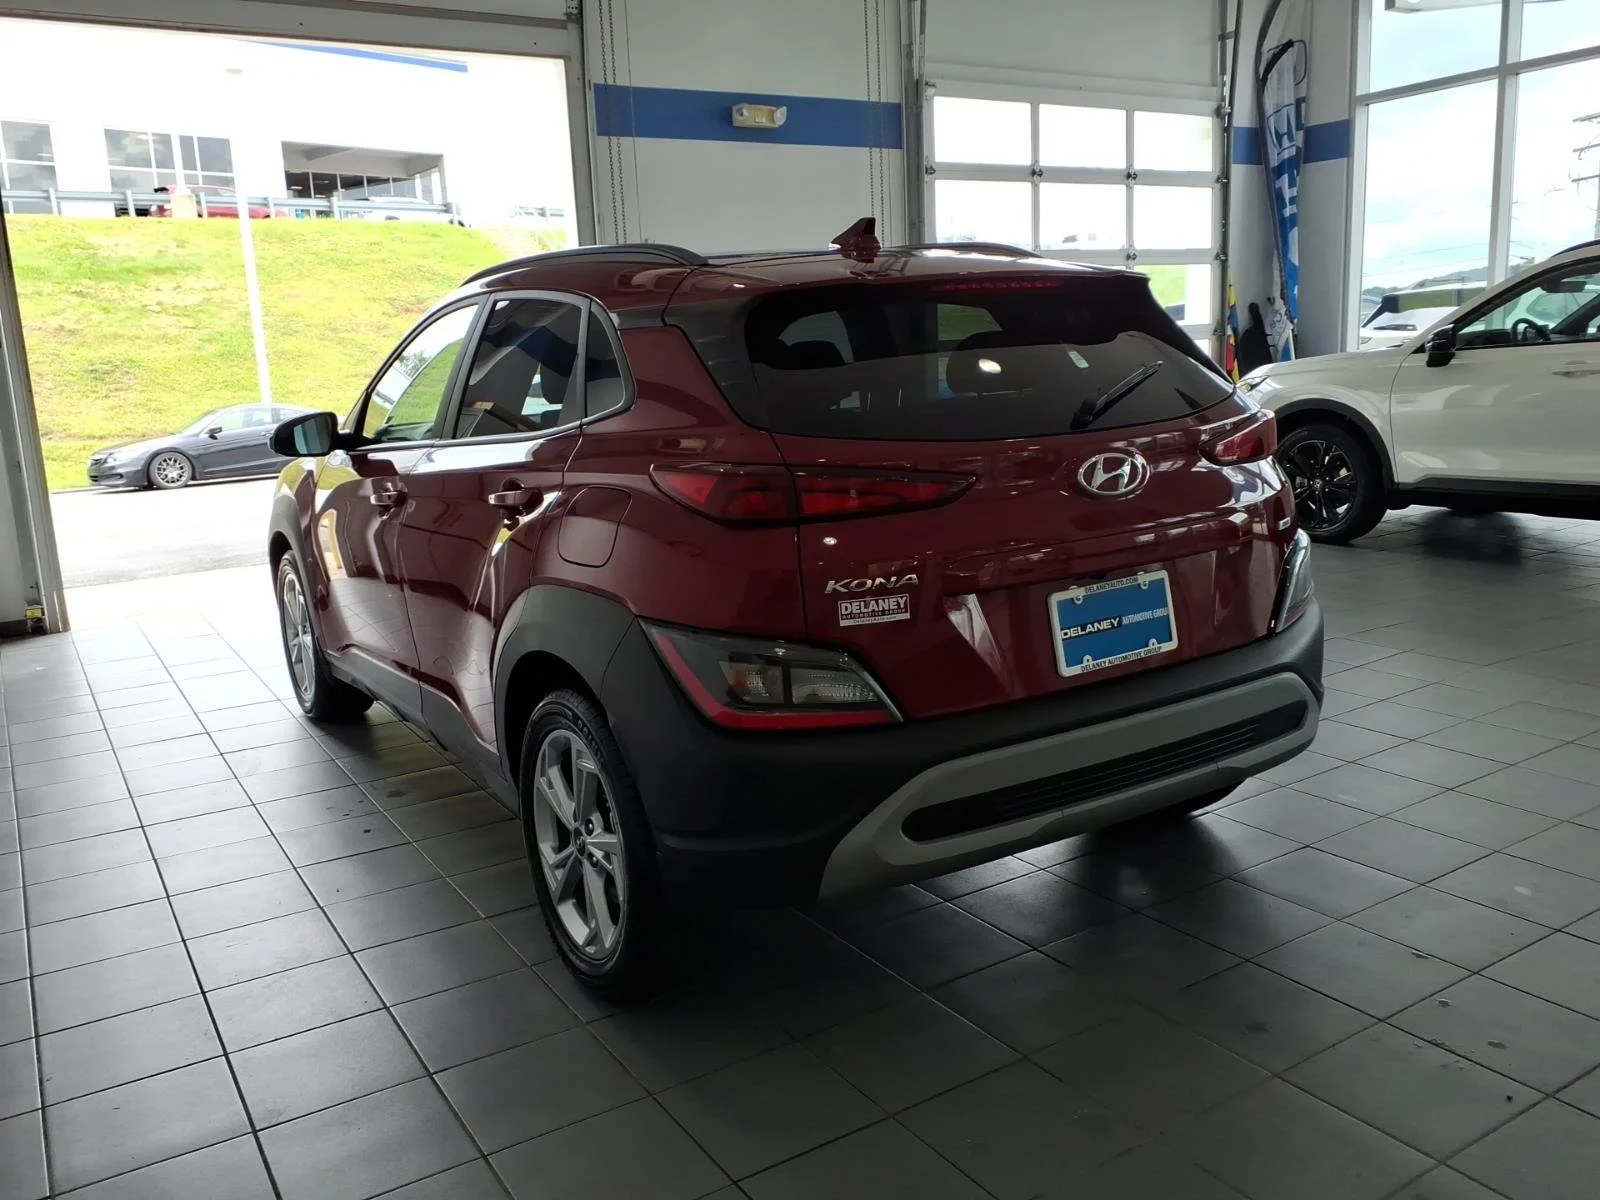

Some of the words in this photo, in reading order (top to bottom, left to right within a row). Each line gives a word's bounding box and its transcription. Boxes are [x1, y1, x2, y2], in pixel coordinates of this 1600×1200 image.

[825, 574, 918, 593] KONA
[1085, 577, 1138, 594] DELANEYAUTO.COM
[841, 597, 907, 614] DELANEY
[842, 611, 882, 619] AUTOMOTIVE
[1061, 617, 1120, 639] DELANEY
[1122, 610, 1153, 625] AUTOMOTIVE
[1081, 660, 1107, 672] DELANEY
[1107, 652, 1143, 665] AUTOMOTIVE
[1143, 646, 1162, 656] GROUP
